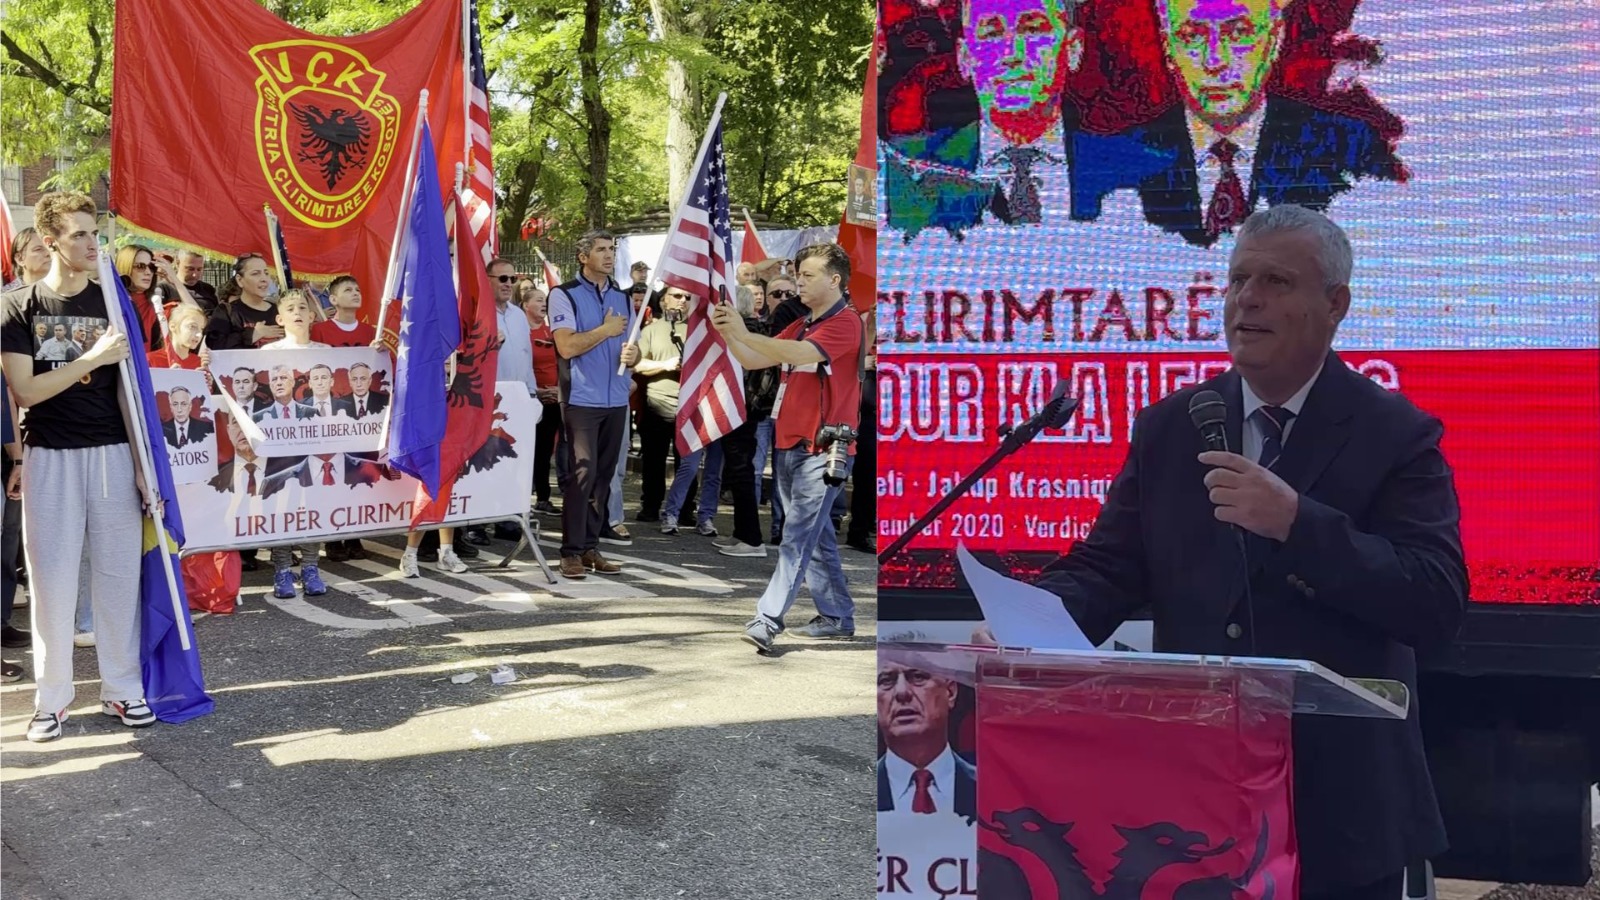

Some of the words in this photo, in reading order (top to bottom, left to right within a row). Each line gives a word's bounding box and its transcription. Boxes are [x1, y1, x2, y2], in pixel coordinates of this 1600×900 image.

[877, 271, 1228, 343] LIRIMTARË
[276, 426, 297, 440] FOR
[299, 425, 319, 439] THE
[321, 422, 383, 438] LIBERATORS
[235, 513, 276, 537] LIRI
[283, 506, 322, 533] PËR
[330, 492, 472, 532] ÇLIRIMTËT
[950, 513, 1004, 538] 2020
[1024, 514, 1097, 539] Verdic
